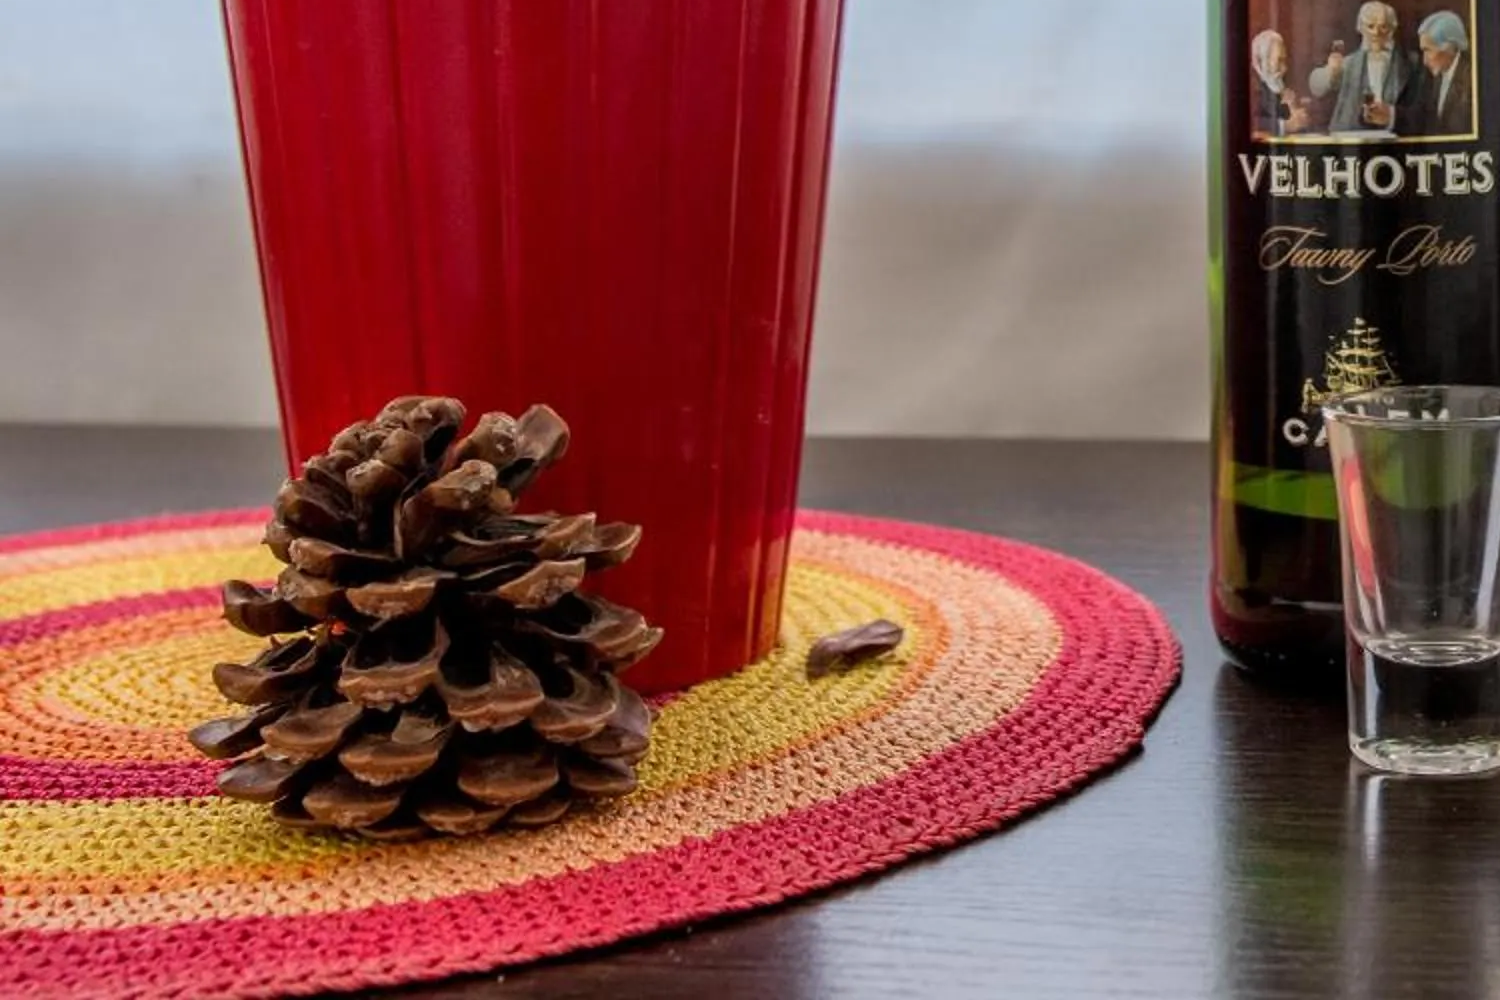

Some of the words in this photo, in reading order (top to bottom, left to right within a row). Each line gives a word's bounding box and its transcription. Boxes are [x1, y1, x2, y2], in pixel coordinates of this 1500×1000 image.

[1238, 151, 1496, 199] VELHOTES
[1258, 225, 1378, 286] Tawny
[1375, 224, 1479, 275] Porto
